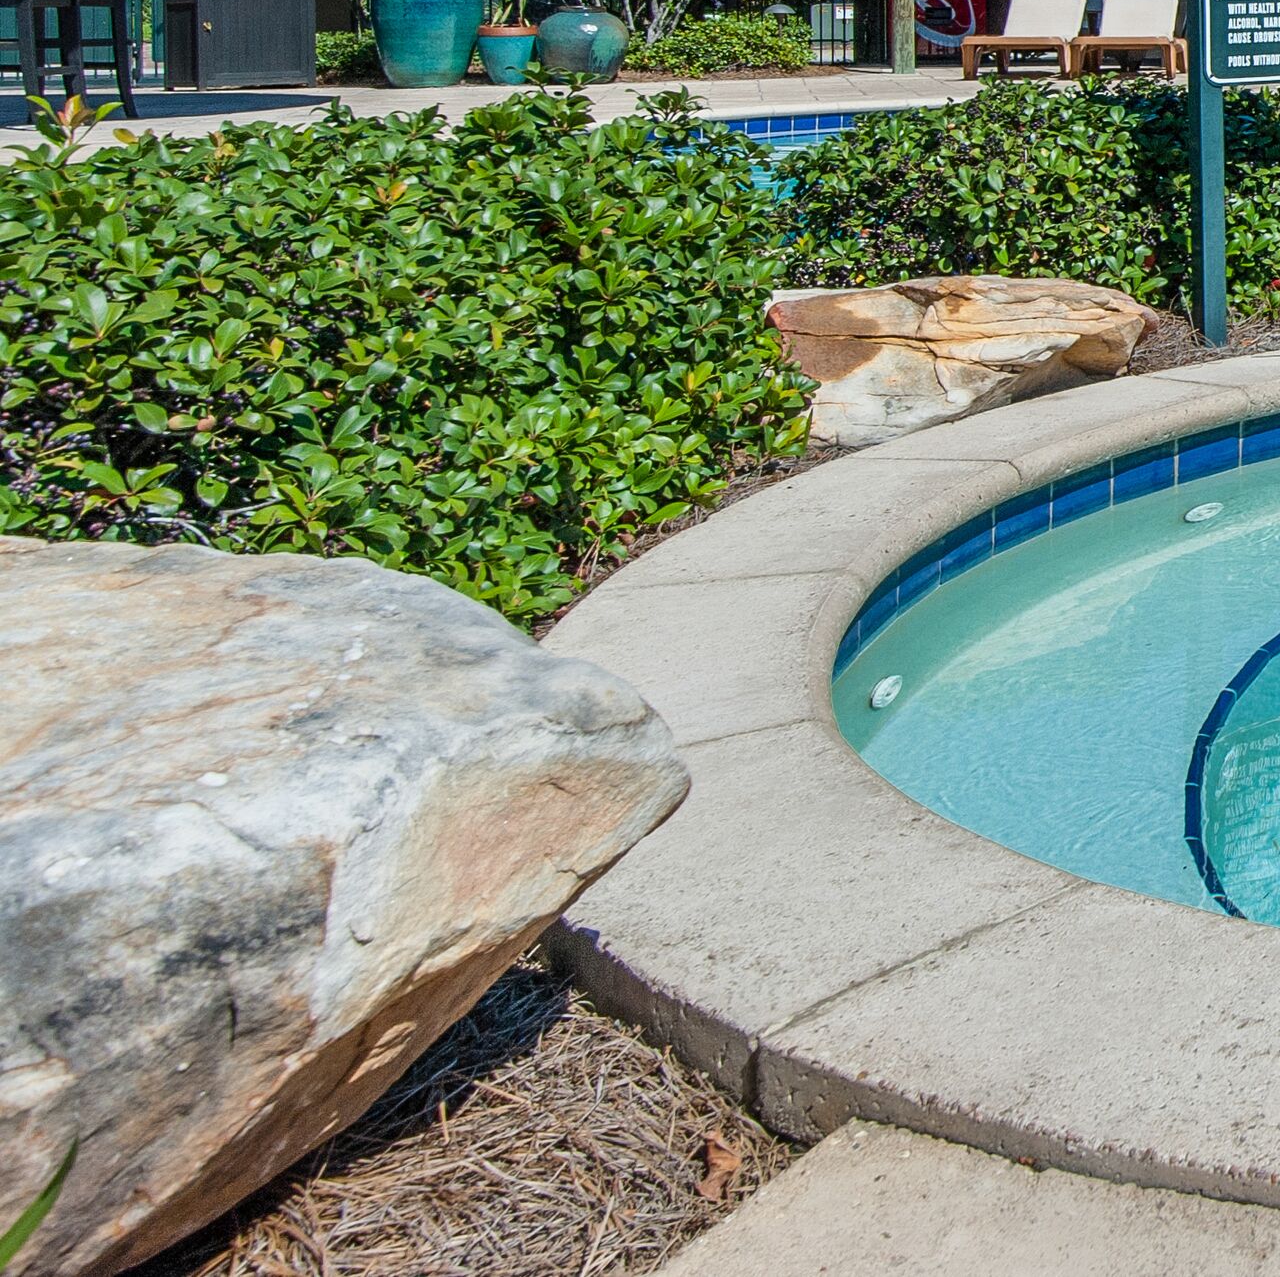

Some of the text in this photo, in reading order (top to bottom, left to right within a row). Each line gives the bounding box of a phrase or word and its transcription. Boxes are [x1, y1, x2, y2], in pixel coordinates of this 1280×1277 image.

[1228, 3, 1246, 14] WITH
[1248, 2, 1275, 14] HEALTH
[1228, 32, 1251, 44] CAUSE
[1228, 56, 1250, 67] POOLS
